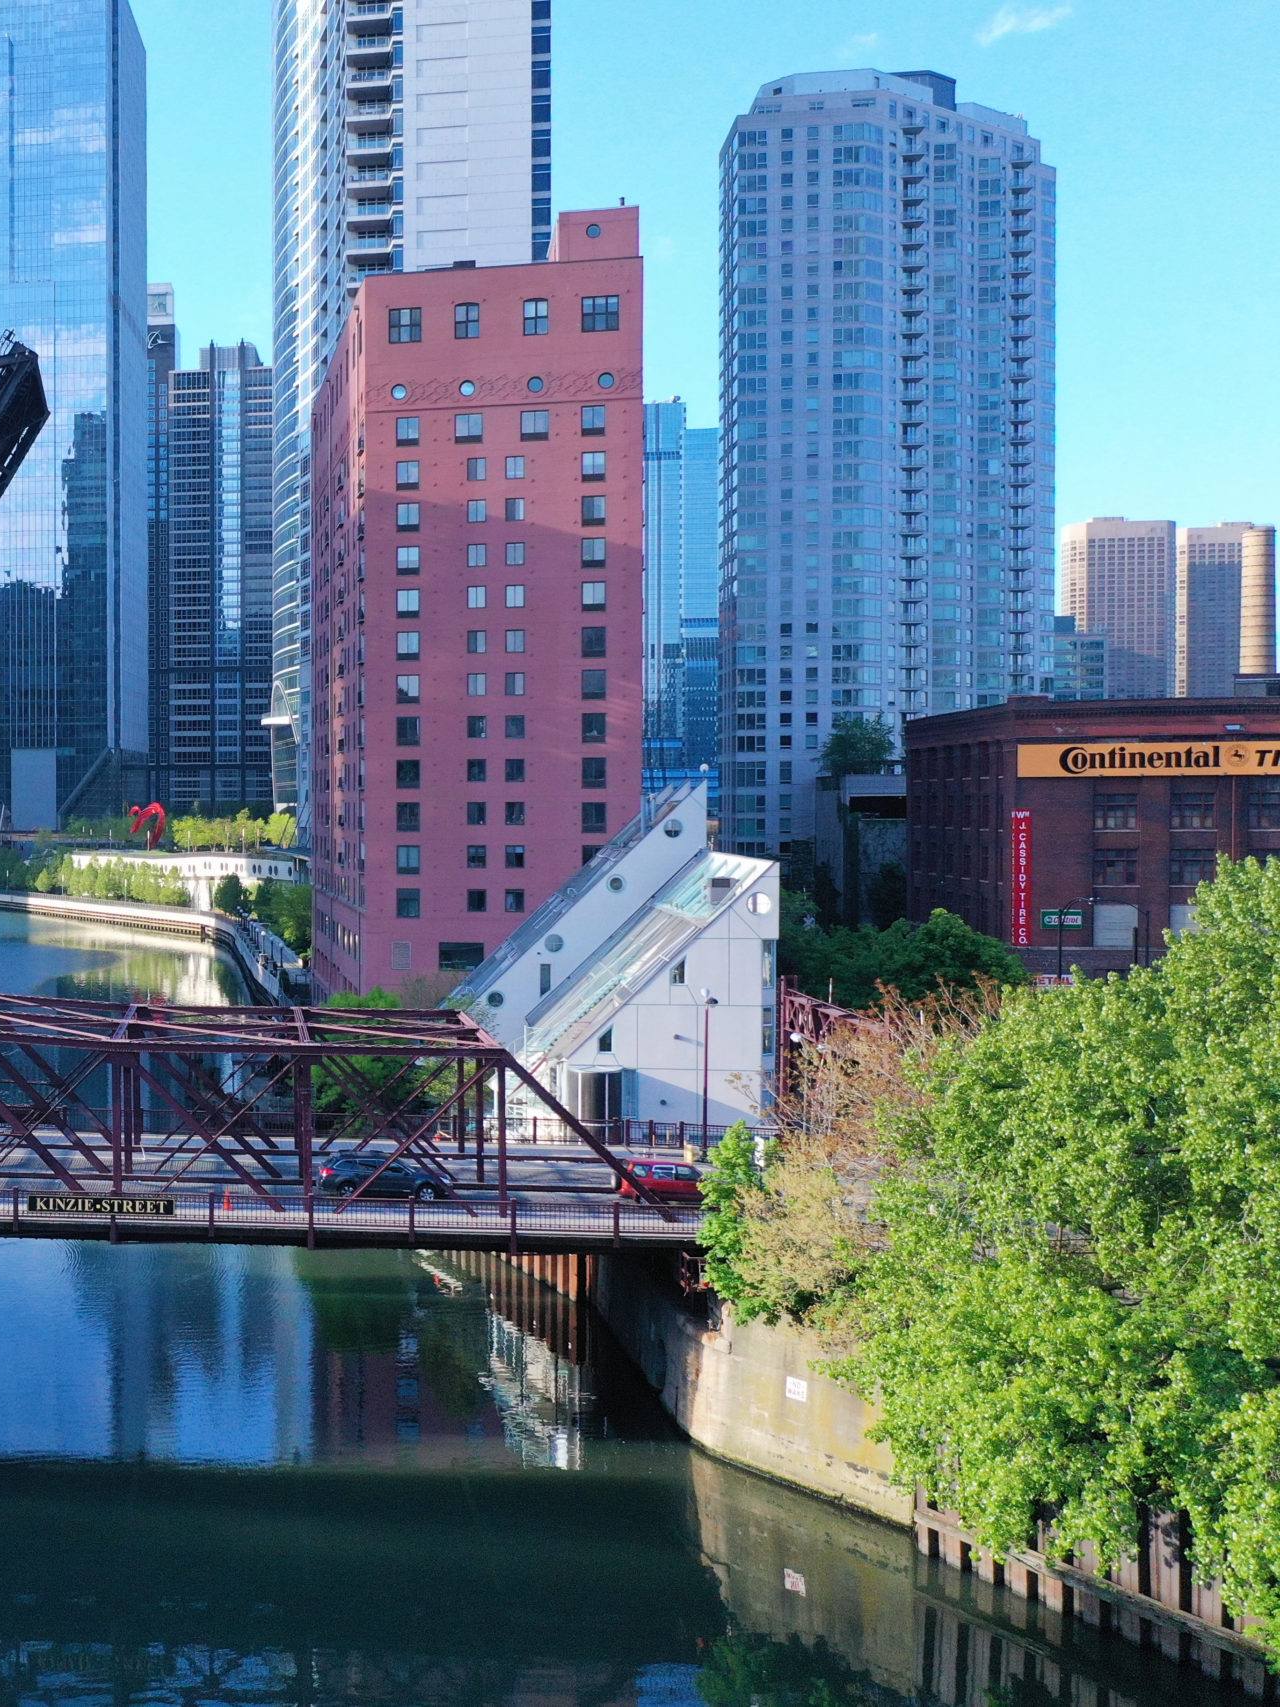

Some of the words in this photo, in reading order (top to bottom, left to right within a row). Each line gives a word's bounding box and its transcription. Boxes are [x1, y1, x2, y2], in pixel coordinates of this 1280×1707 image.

[1059, 745, 1221, 775] Continental
[1018, 832, 1027, 890] CASSIDY
[1018, 892, 1027, 925] TIRE
[1018, 927, 1028, 944] CO.
[36, 1197, 94, 1211] KINZIE
[101, 1199, 168, 1214] STREET
